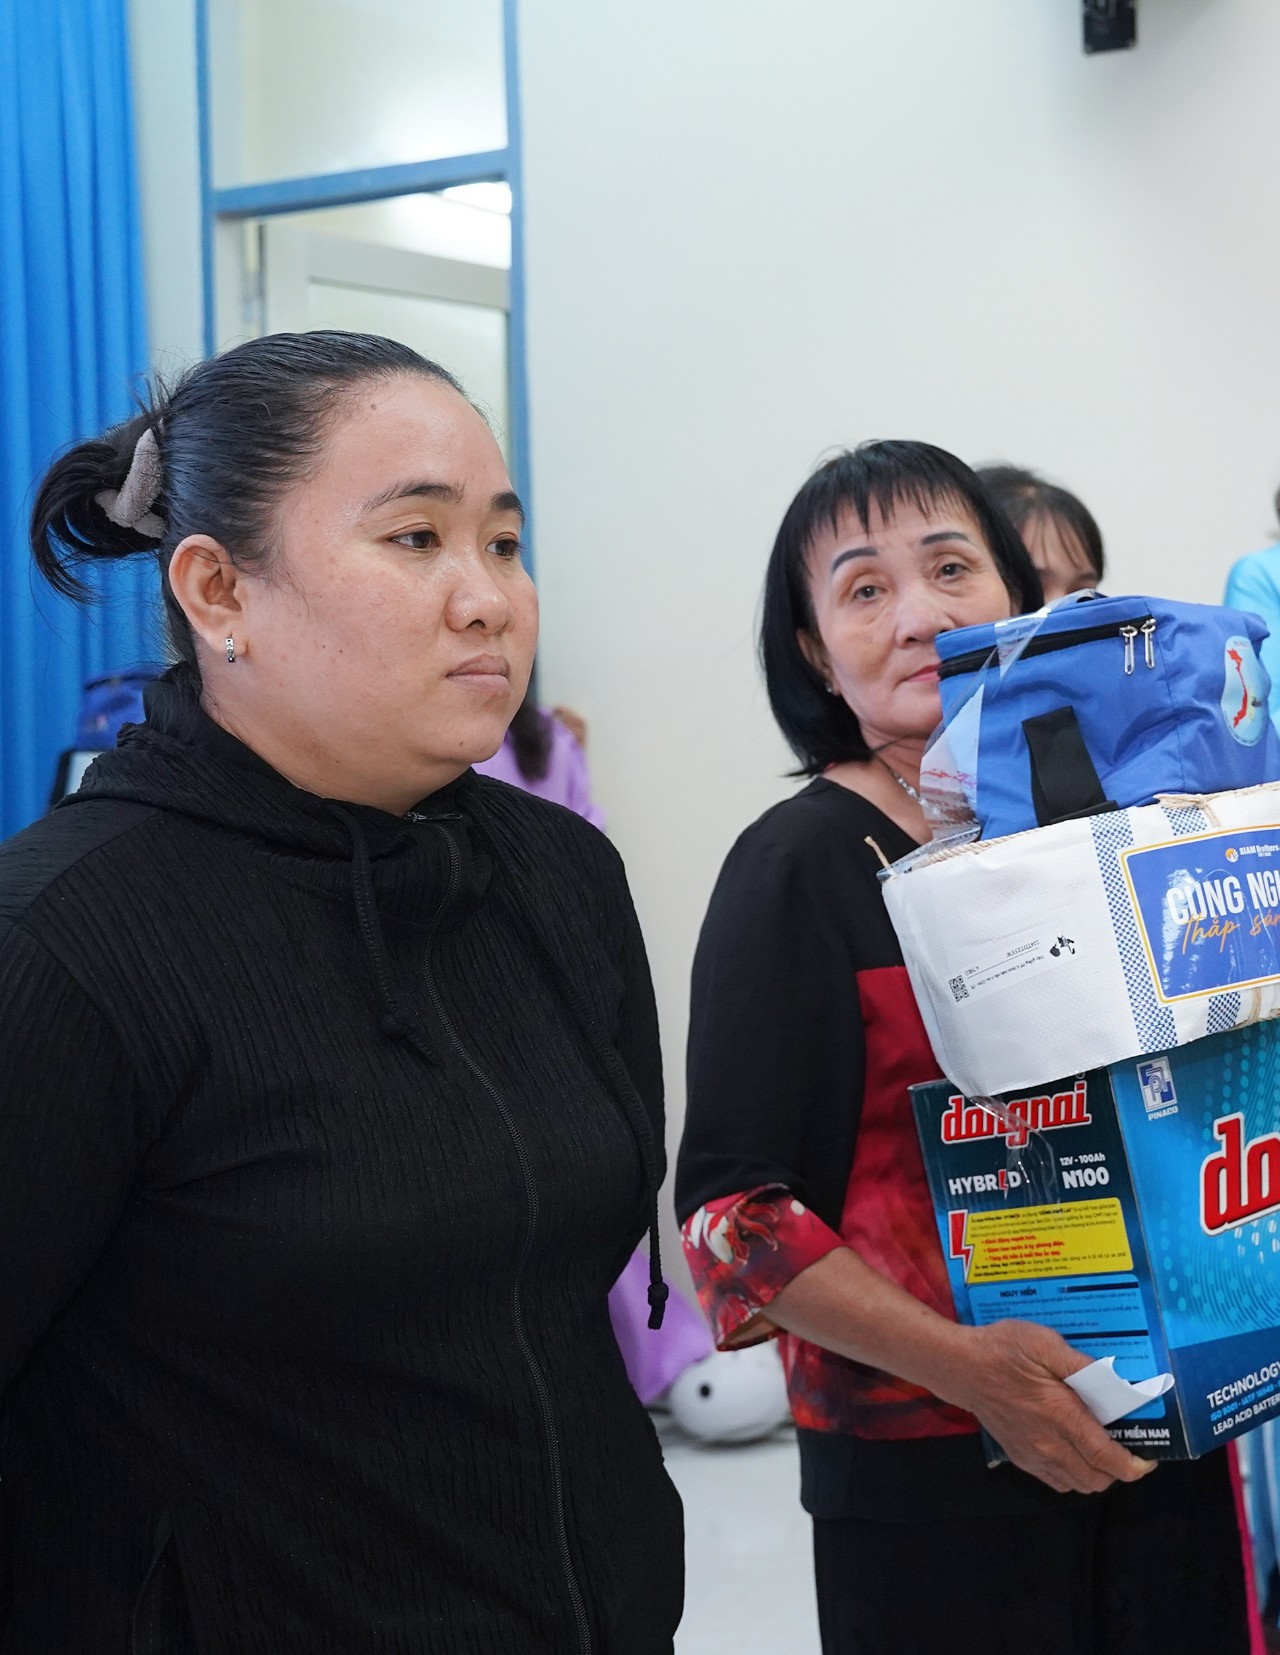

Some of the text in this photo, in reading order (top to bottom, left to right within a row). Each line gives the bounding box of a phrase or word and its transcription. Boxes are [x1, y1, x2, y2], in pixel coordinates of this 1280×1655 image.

[1239, 846, 1256, 856] SIAM
[1166, 877, 1244, 926] CÙNG
[1148, 1106, 1179, 1121] PINACO
[1060, 1156, 1073, 1167] 12V
[1078, 1152, 1106, 1165] 100Ah
[1062, 1166, 1110, 1190] N100
[1210, 1411, 1222, 1422] ISO
[1212, 1417, 1234, 1436] LEAD
[1235, 1408, 1253, 1425] ACID
[1147, 1428, 1170, 1438] NAM
